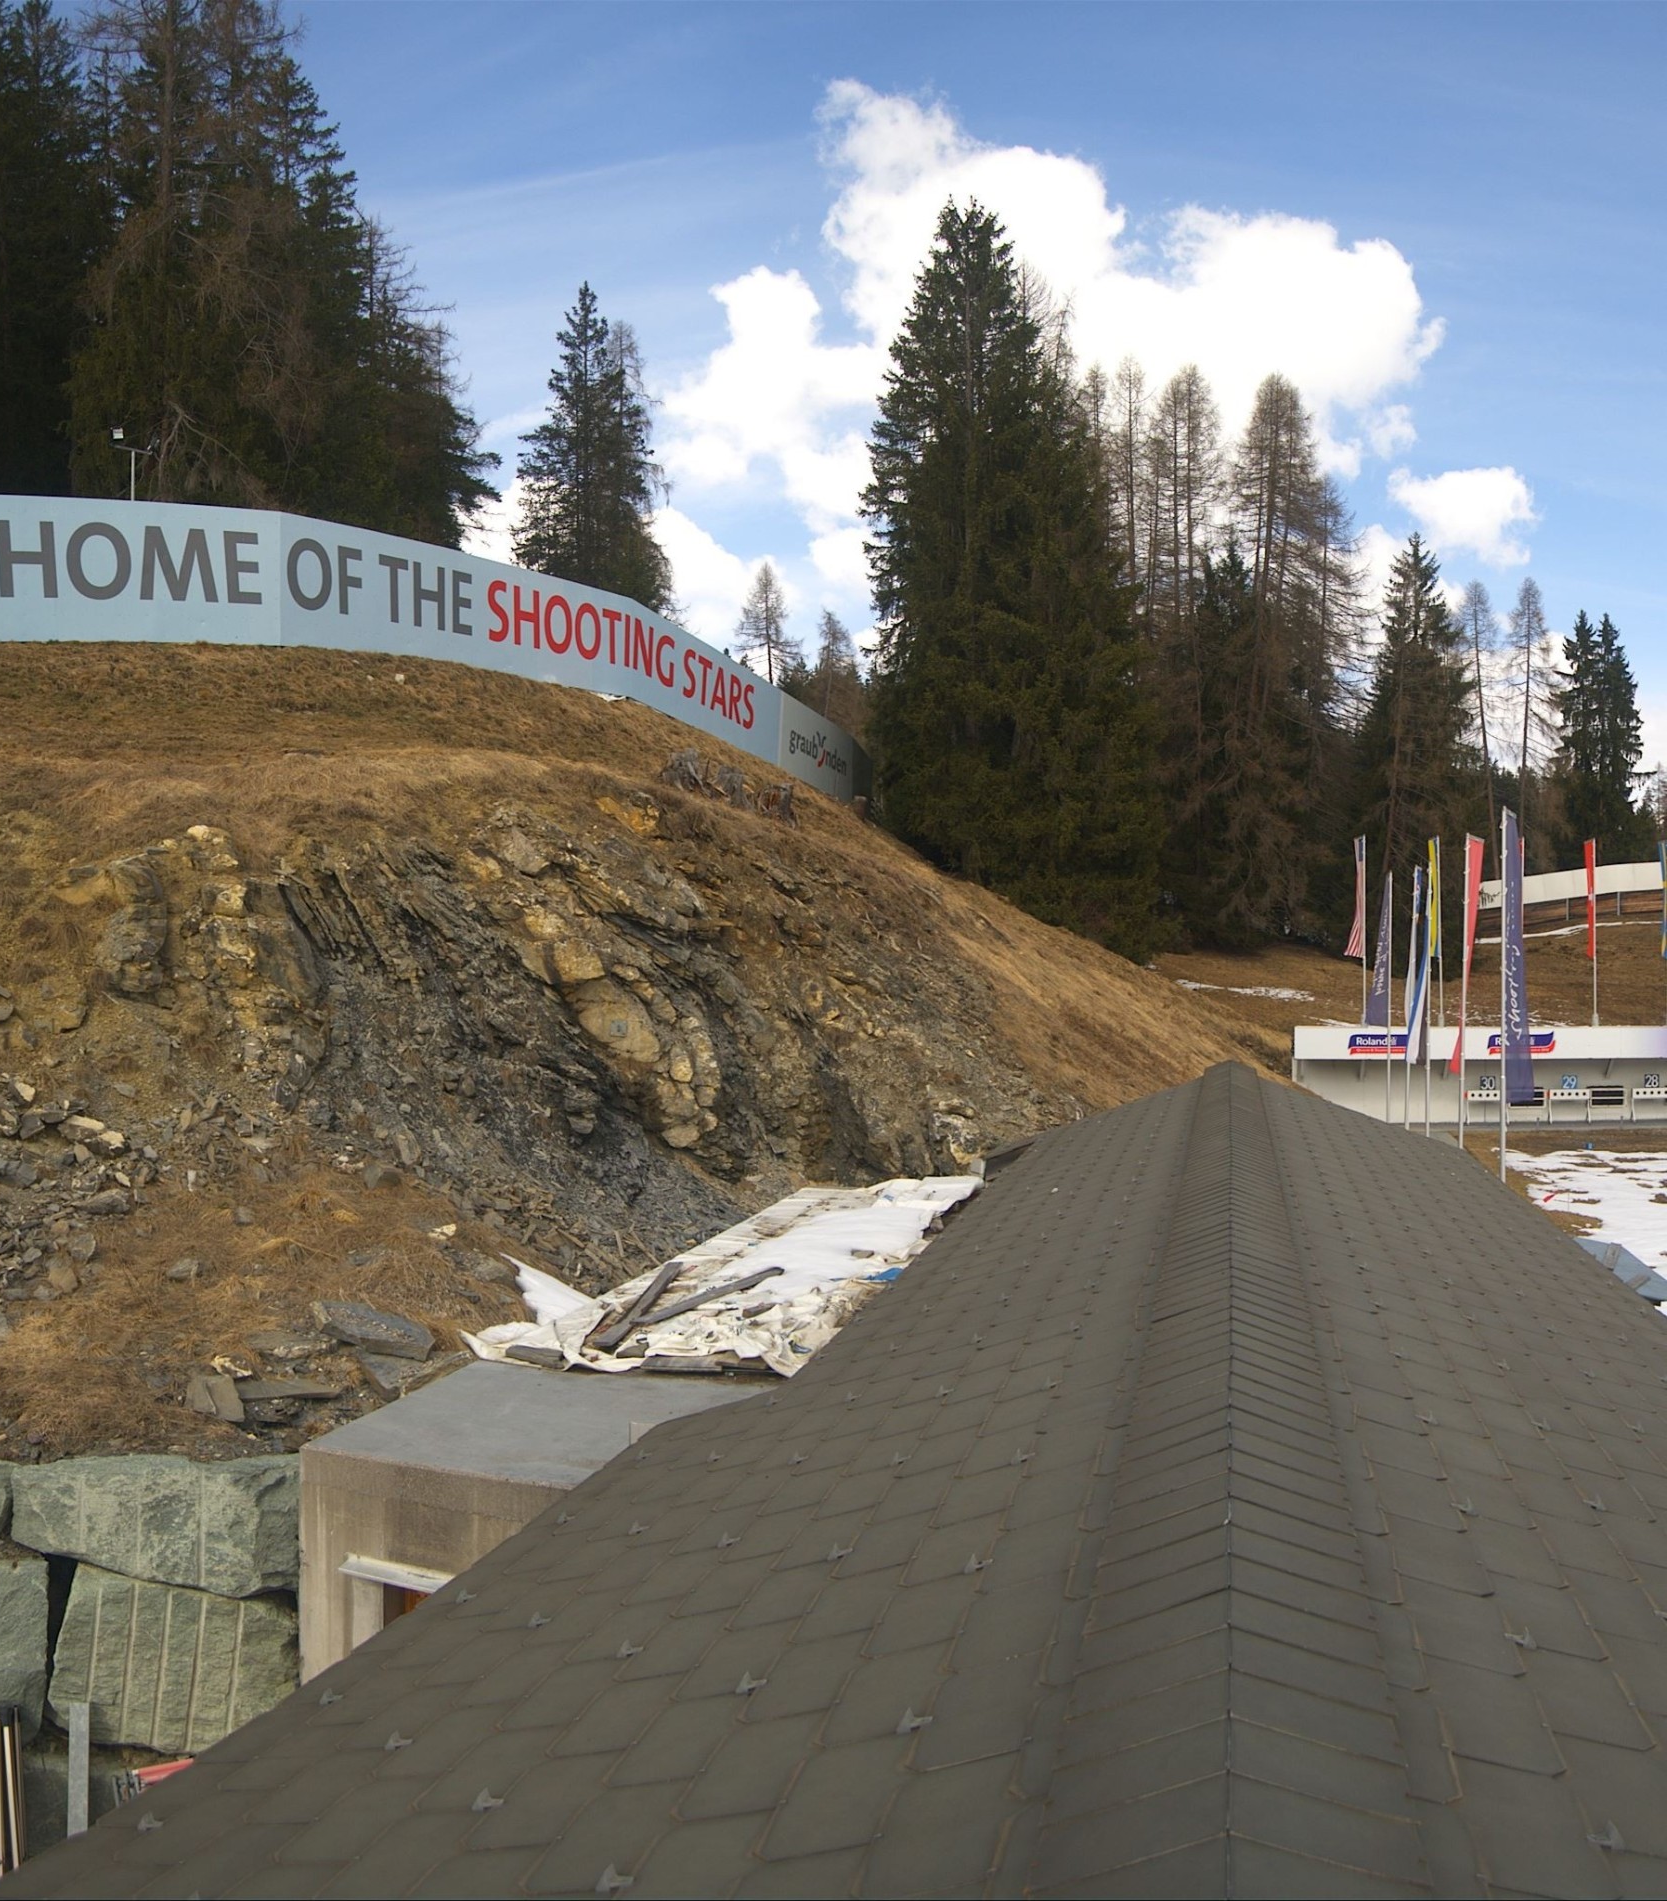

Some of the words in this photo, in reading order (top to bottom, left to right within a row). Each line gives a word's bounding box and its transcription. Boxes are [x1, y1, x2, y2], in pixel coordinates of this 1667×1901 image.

[286, 537, 363, 615] OF
[378, 554, 473, 636] THE
[487, 579, 676, 688] SHOOTING
[682, 648, 755, 730] STARS
[1356, 1037, 1388, 1046] Roland
[1481, 1077, 1495, 1089] 30
[1563, 1075, 1576, 1088] 29
[1645, 1074, 1658, 1087] 28
